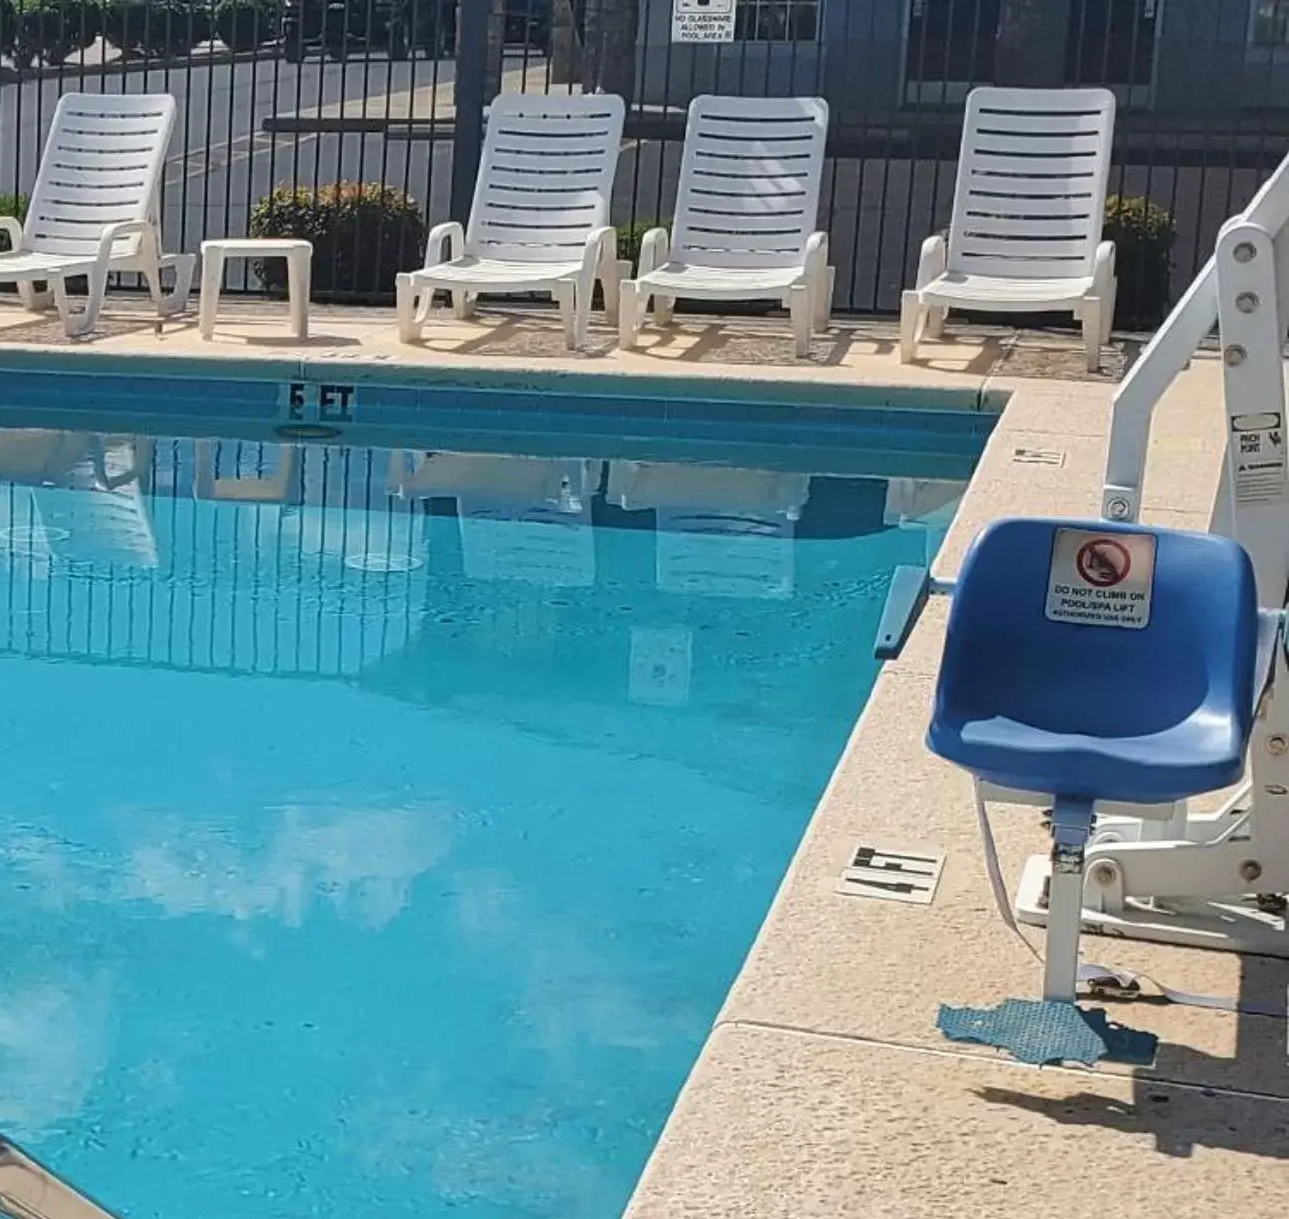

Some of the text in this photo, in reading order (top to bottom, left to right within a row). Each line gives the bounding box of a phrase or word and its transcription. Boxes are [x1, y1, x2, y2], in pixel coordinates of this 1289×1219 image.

[1054, 585, 1145, 601] DO NOT CLIMB ON
[1061, 598, 1135, 613] POOL/SPA LIFT
[845, 847, 937, 894] 4 FT
